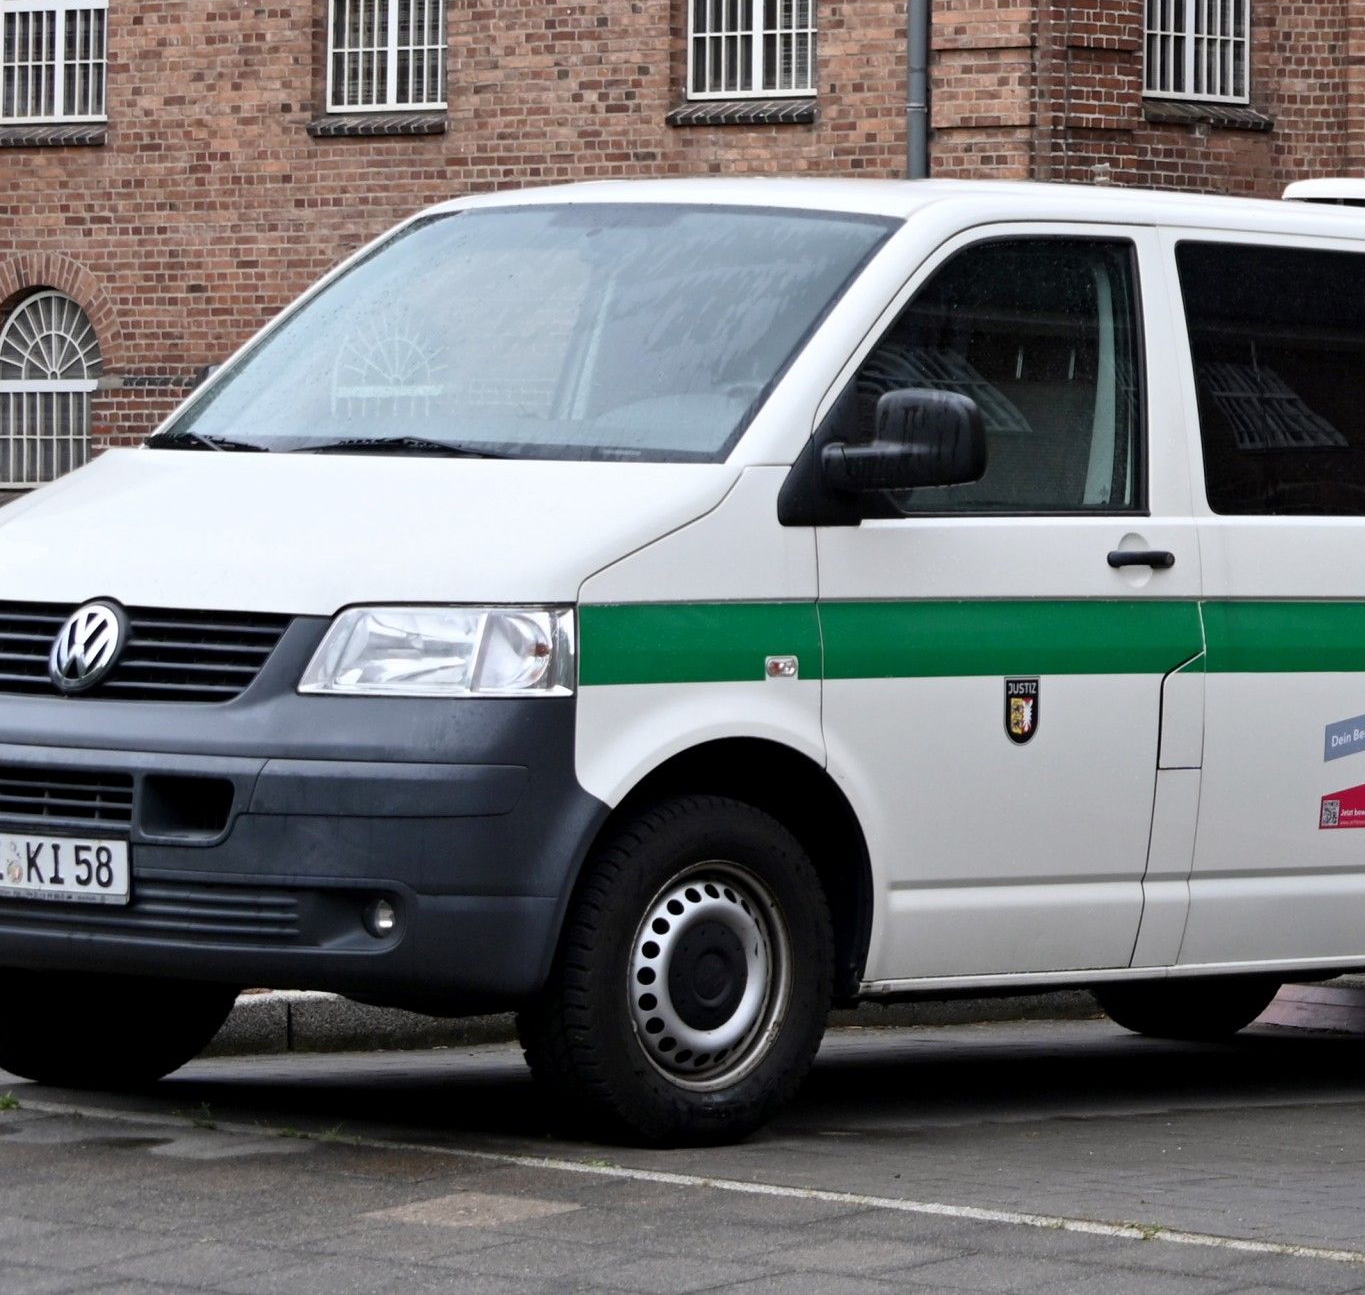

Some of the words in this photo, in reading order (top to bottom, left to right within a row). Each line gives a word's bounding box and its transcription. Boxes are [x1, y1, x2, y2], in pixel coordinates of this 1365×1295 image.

[52, 604, 119, 686] VW
[1008, 682, 1037, 694] JUSTIZ
[1331, 732, 1352, 747] Dein
[1340, 808, 1354, 817] Jetzt
[26, 841, 65, 885] KI
[74, 844, 114, 888] 58
